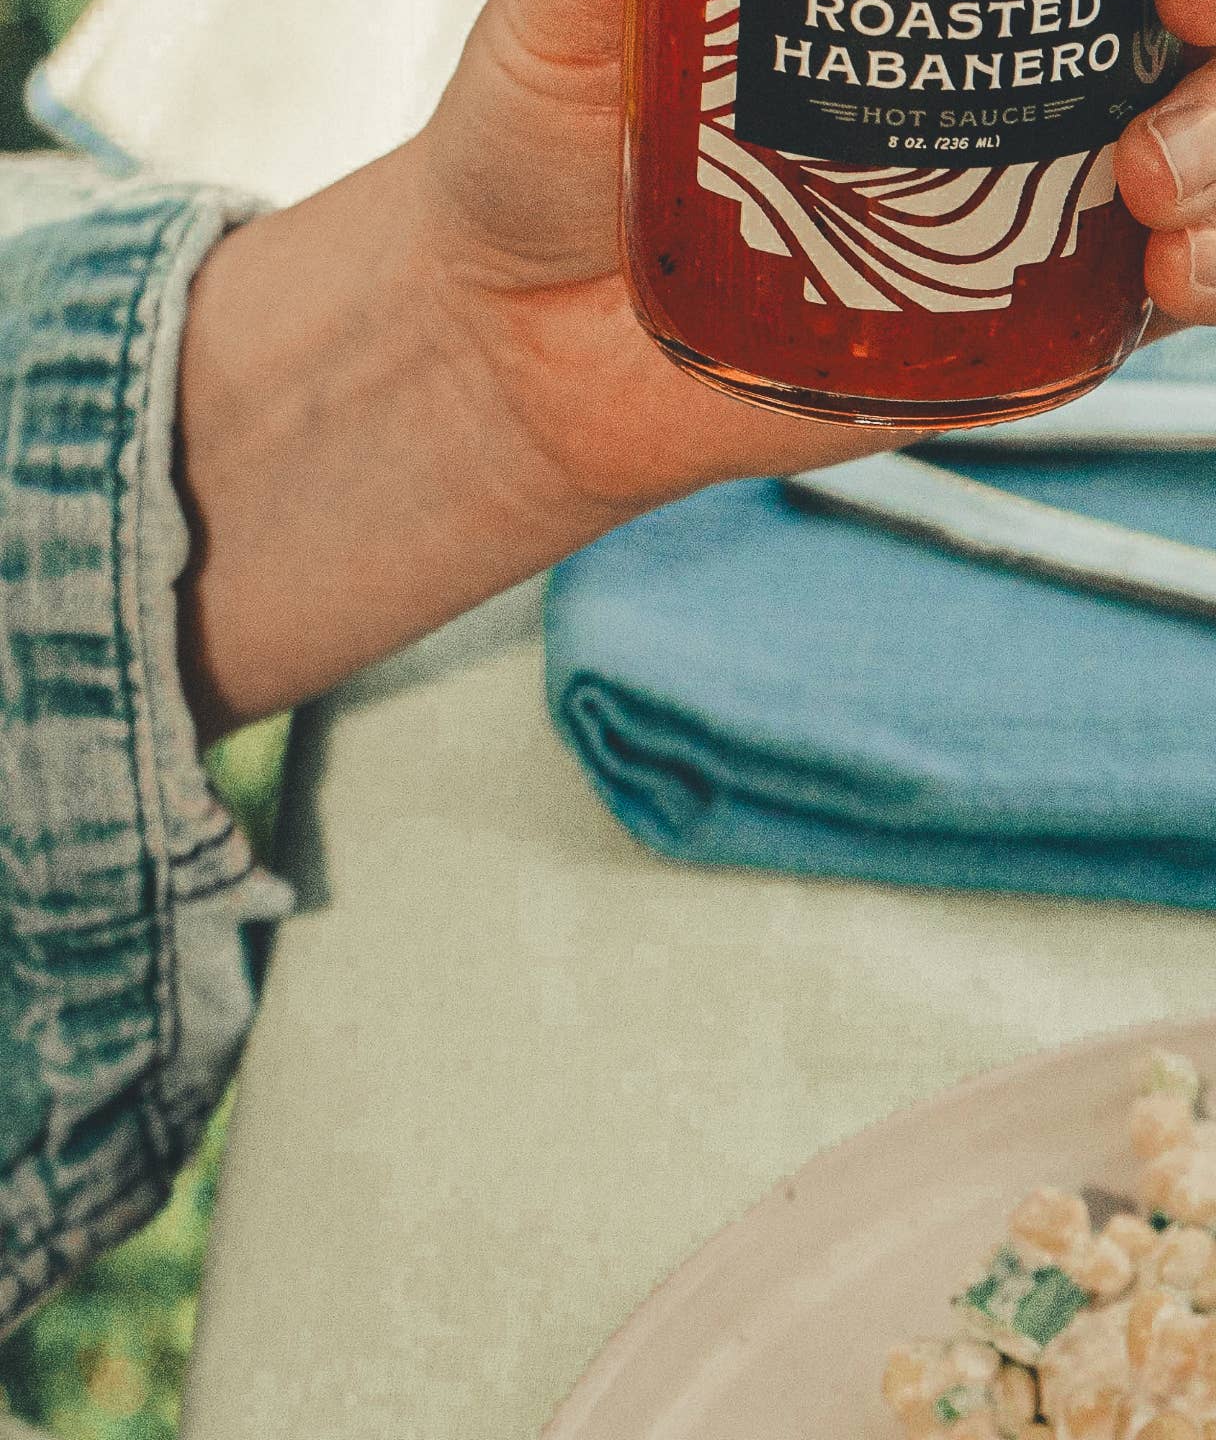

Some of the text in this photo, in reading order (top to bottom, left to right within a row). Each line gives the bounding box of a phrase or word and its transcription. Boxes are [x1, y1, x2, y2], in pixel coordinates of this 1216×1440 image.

[772, 33, 1121, 91] HABANERO
[862, 105, 1037, 129] HOT SAUCE
[887, 134, 1001, 151] 8 OZ. (236 ML)
